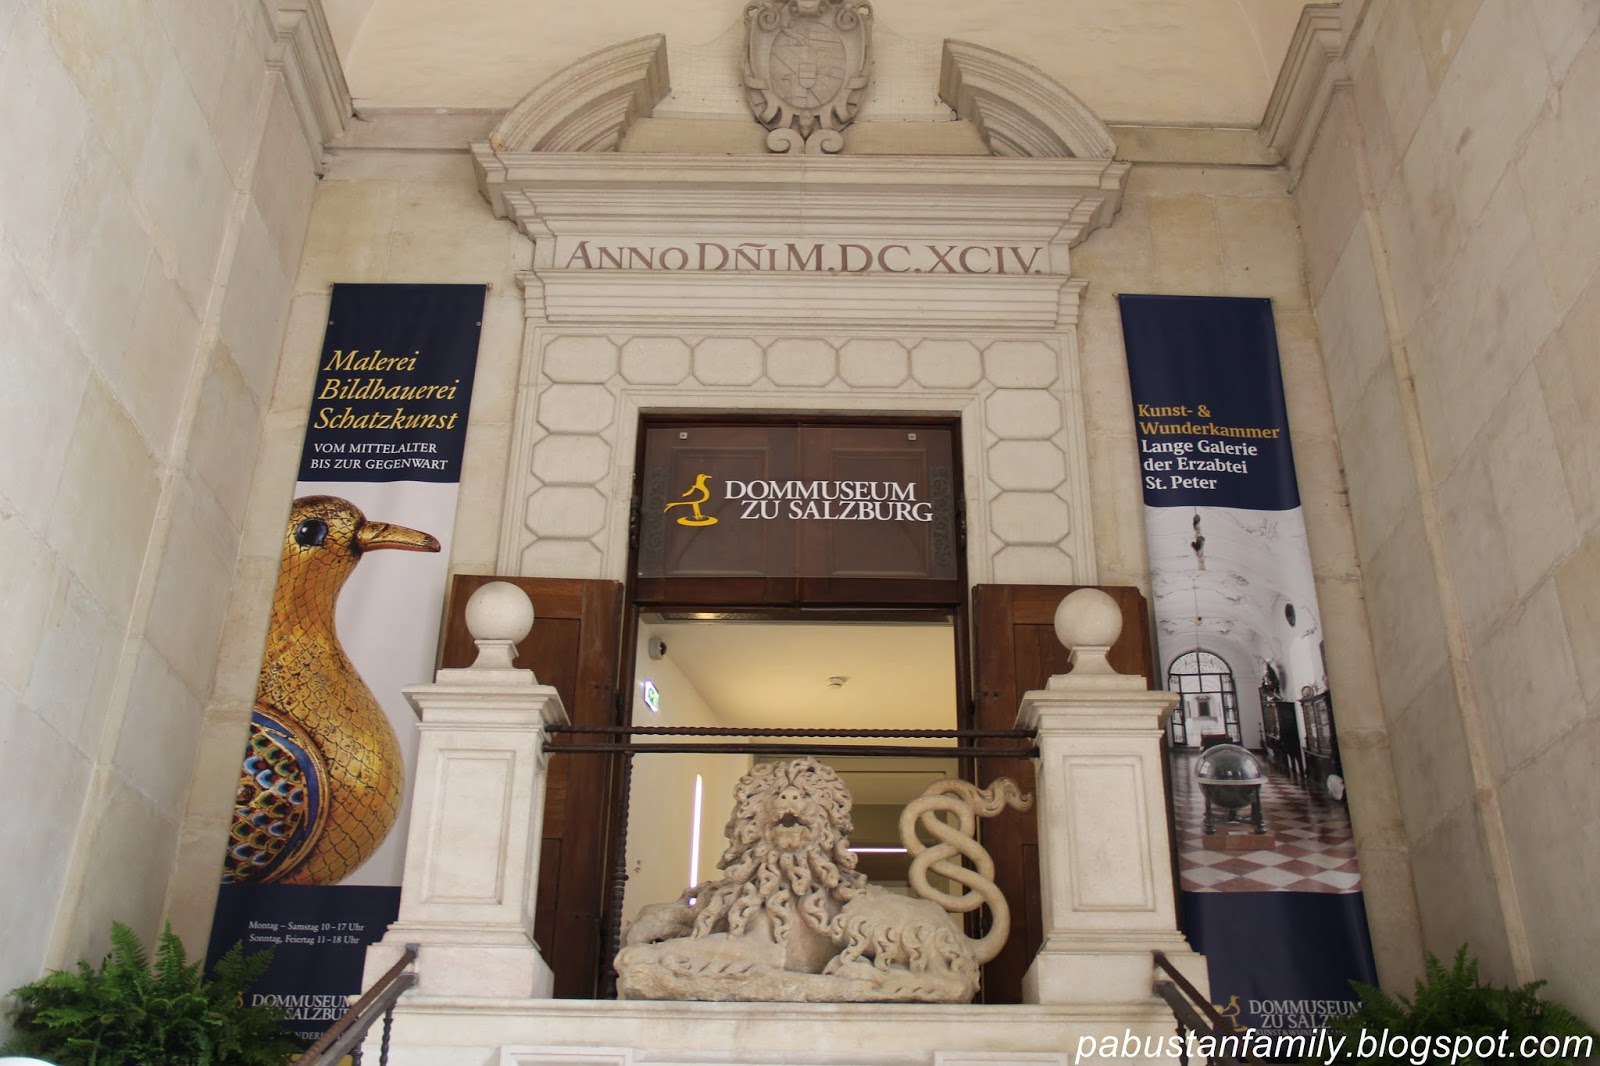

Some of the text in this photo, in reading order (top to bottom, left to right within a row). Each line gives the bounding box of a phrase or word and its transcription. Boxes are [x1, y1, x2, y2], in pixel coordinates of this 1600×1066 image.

[323, 350, 420, 371] Malerei
[318, 378, 460, 400] Bildhauerei
[313, 407, 458, 430] Schatzkunst
[1137, 404, 1212, 418] Kunst- &
[1139, 421, 1280, 439] Wunderkammer
[313, 442, 437, 454] VOM MITTELALTER
[1141, 439, 1258, 456] Lange Galerie
[310, 458, 449, 471] BIS ZUR GEGENWART
[1143, 457, 1249, 474] der Erzabtei
[1145, 475, 1218, 490] St. Peter
[724, 480, 917, 502] DOMMUSEUM
[739, 500, 934, 522] ZU SALZBURG
[248, 920, 279, 932] Montag
[287, 921, 320, 933] Samstag
[348, 922, 366, 932] Uhr
[248, 933, 283, 945] Sonntag,
[285, 934, 316, 946] Feiertag
[343, 935, 361, 945] Uhr
[283, 1007, 352, 1021] SALZBU
[1260, 1014, 1285, 1029] ZU
